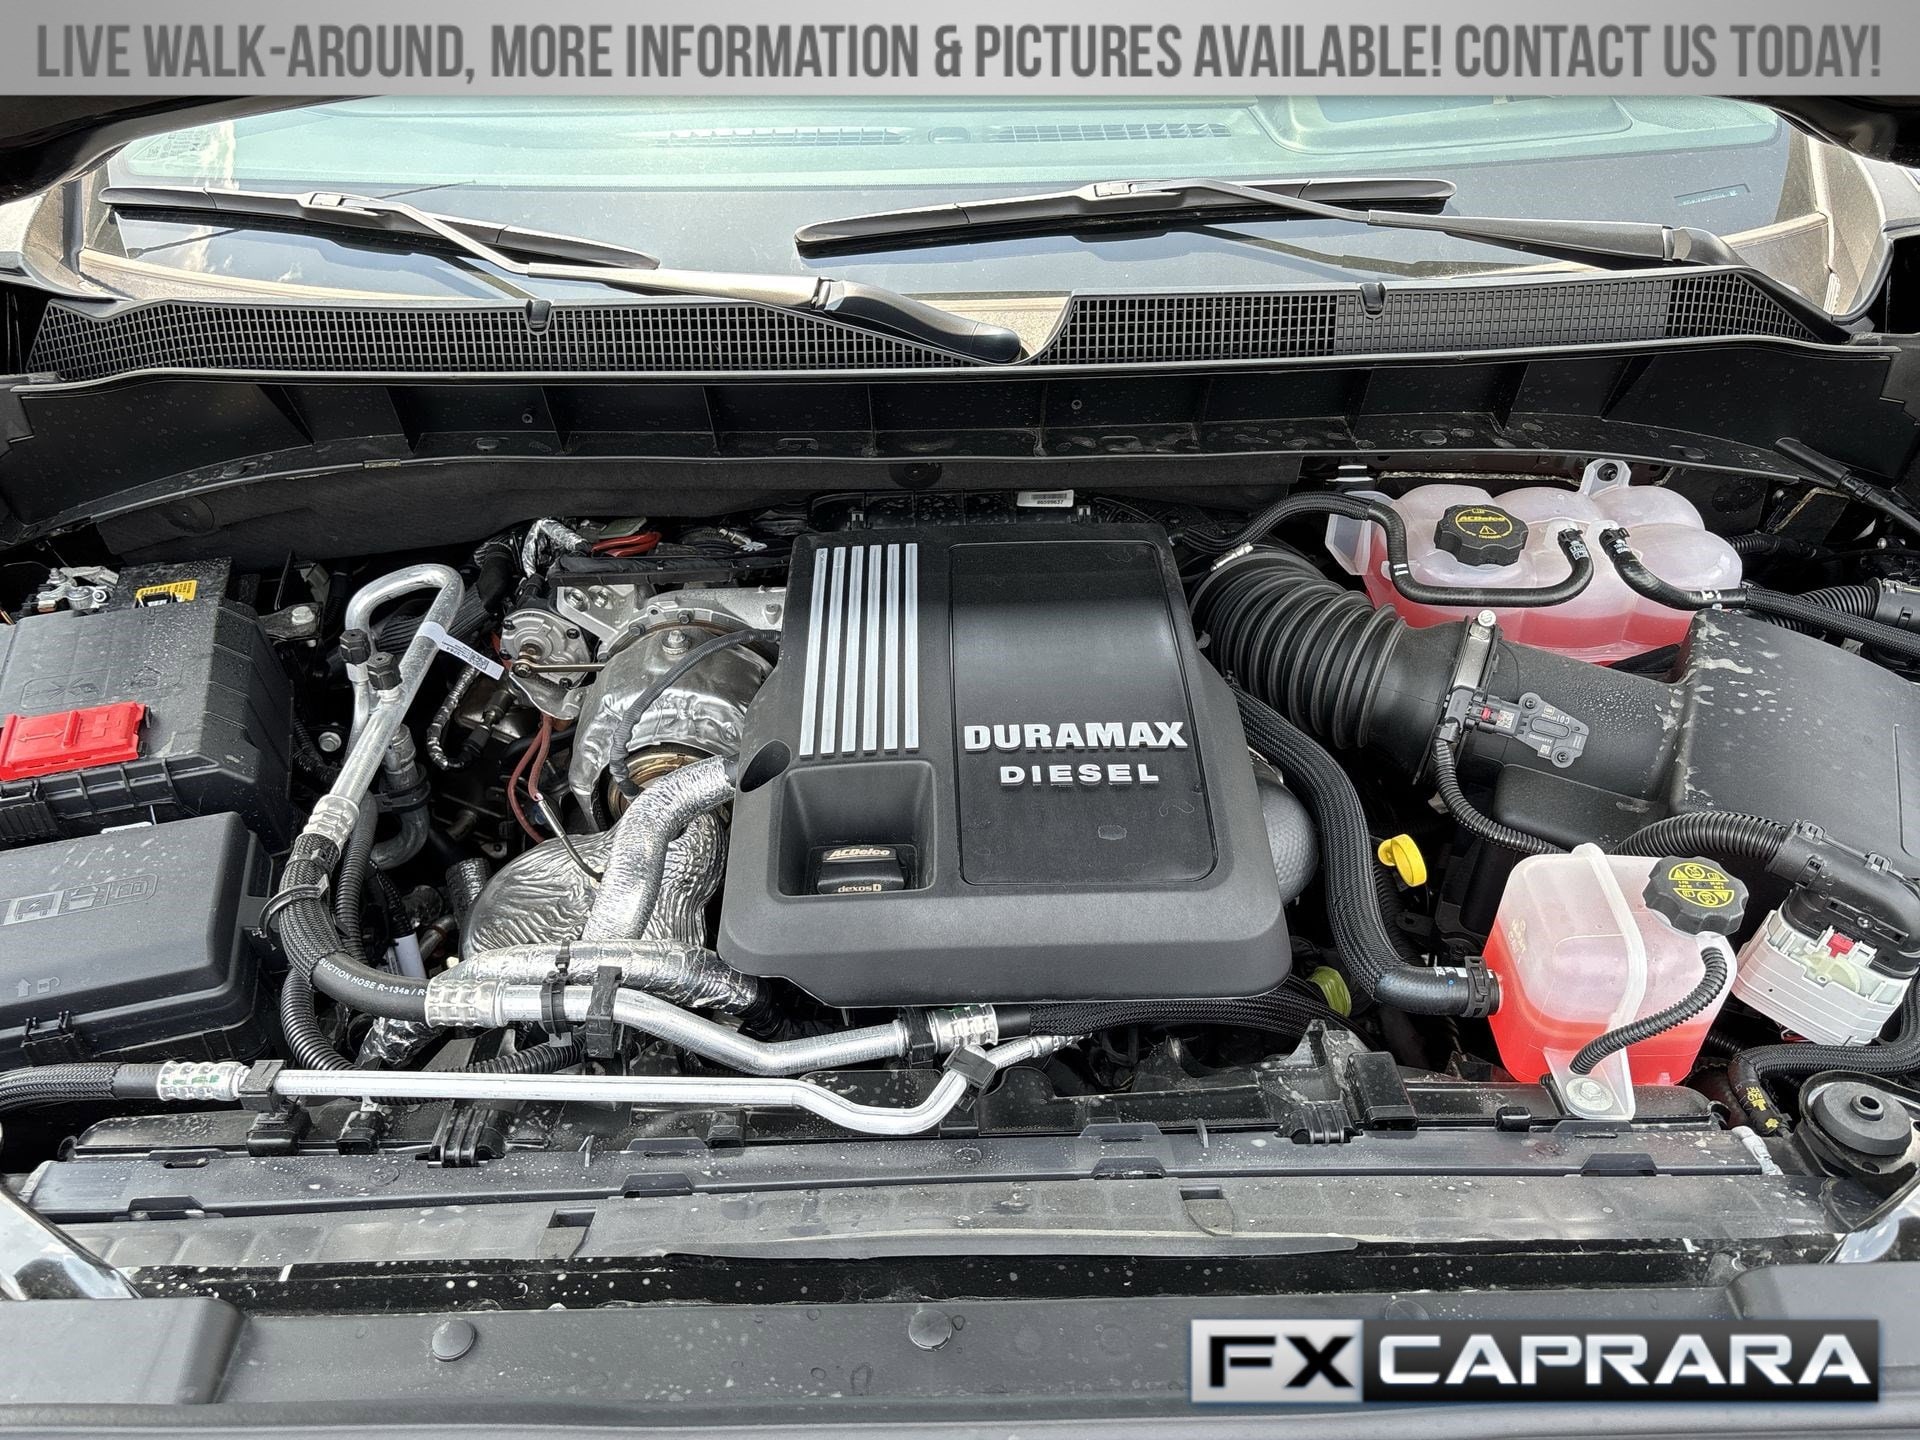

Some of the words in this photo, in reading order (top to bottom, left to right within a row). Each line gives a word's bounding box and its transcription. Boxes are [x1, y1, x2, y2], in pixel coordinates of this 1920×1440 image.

[964, 722, 1188, 750] DURAMAX
[1000, 763, 1159, 786] DIESEL
[829, 848, 890, 859] ACDelco
[319, 957, 351, 981] SUCTION
[350, 975, 376, 990] HOSE
[377, 983, 410, 996] R-134a
